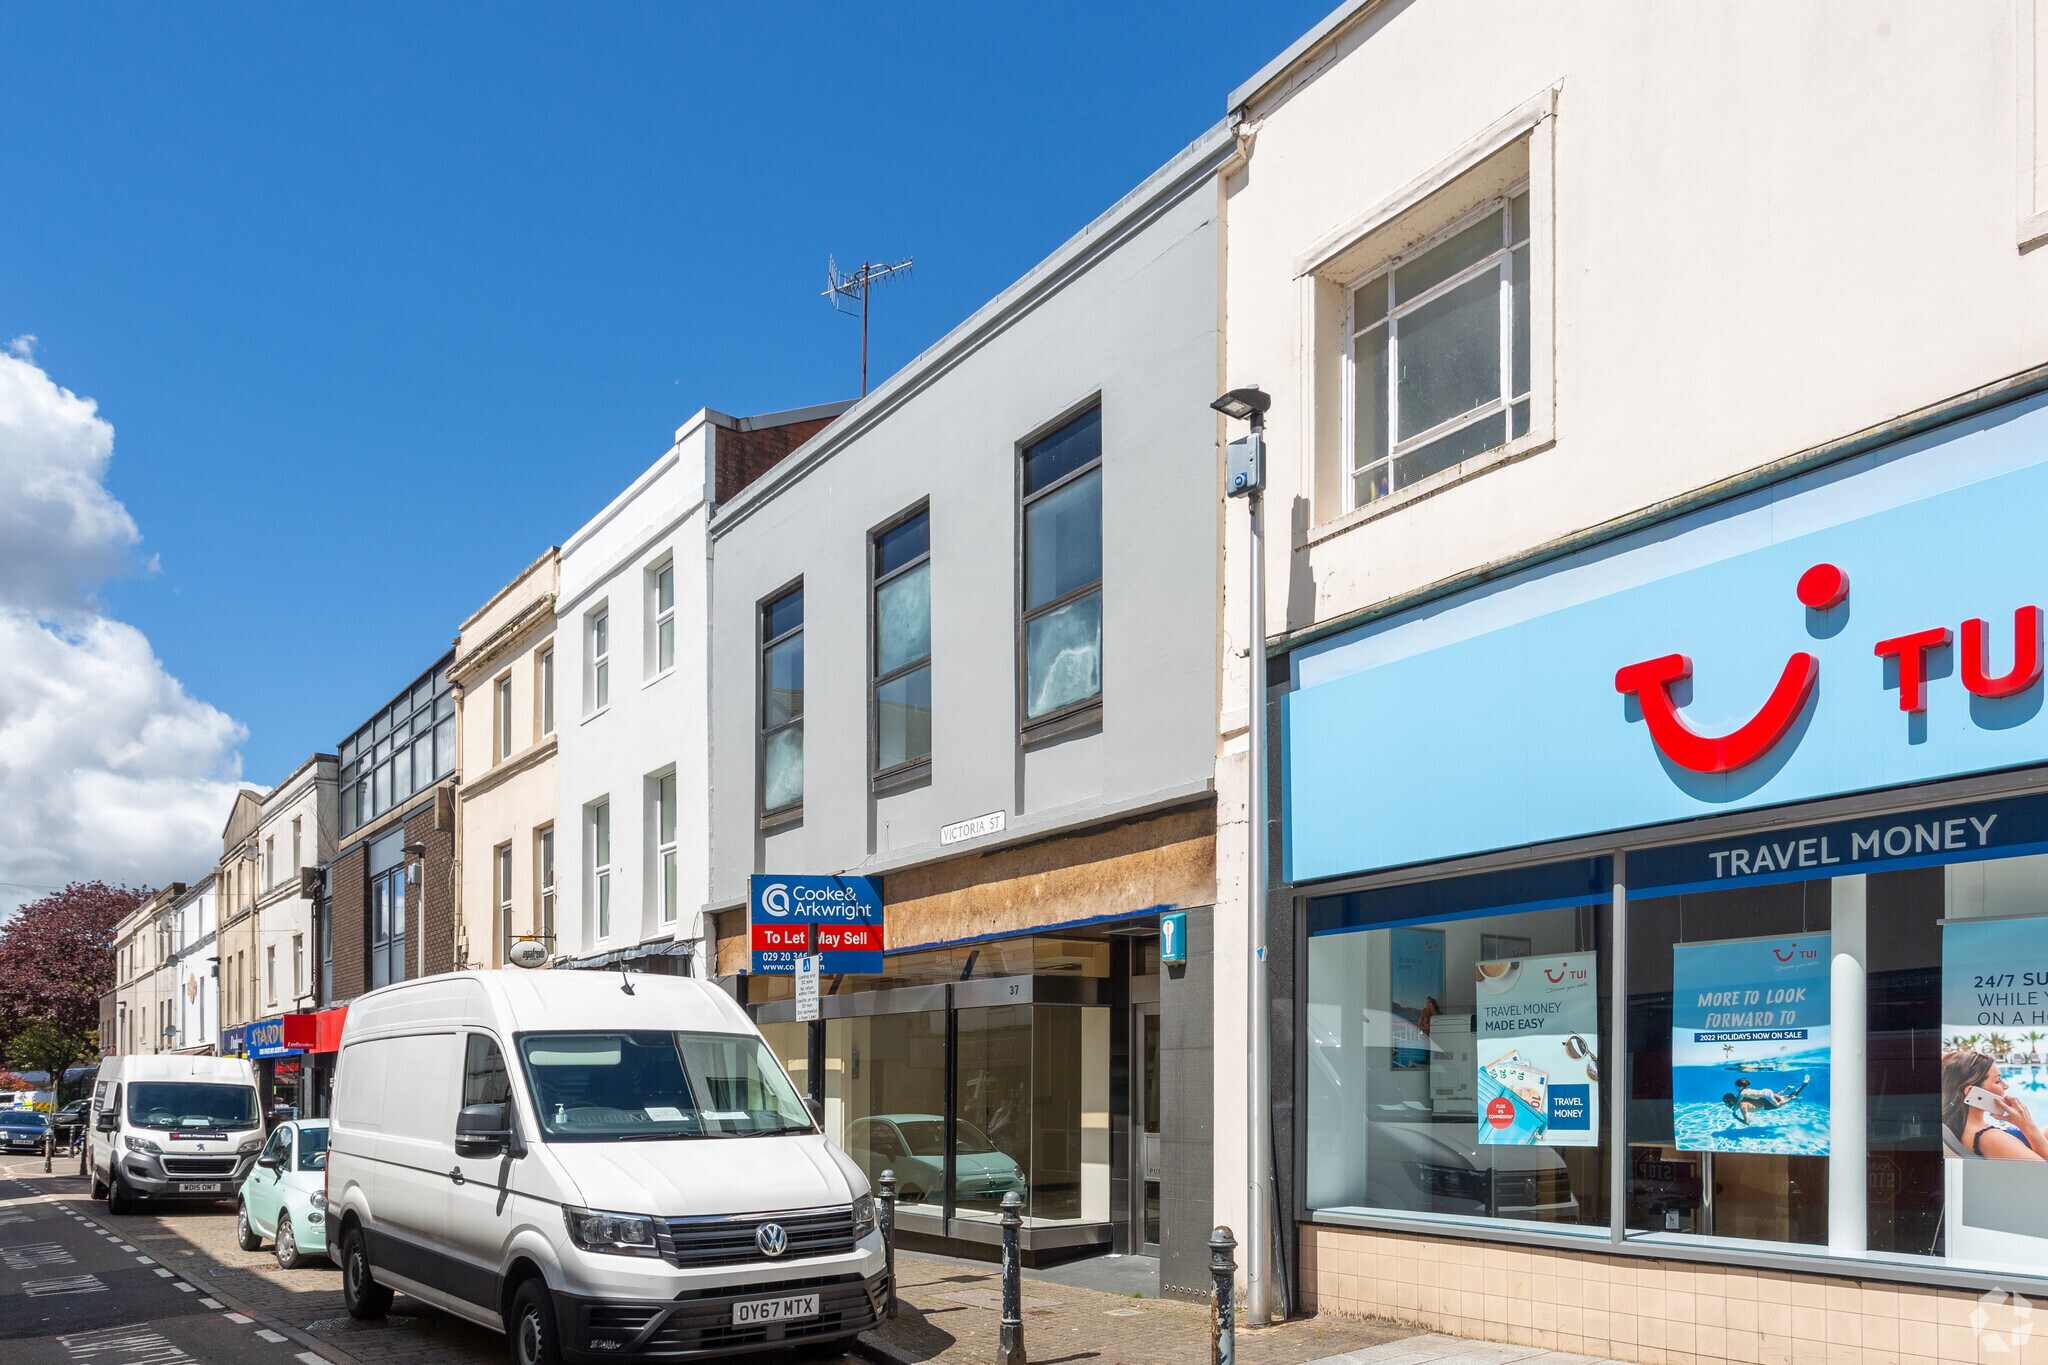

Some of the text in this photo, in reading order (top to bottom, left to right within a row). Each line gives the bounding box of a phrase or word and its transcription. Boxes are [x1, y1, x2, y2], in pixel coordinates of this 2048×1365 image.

[943, 815, 1003, 841] VICTORIA ST.
[1709, 814, 1998, 878] TRAVEL MONEY
[794, 902, 872, 920] Arkwright
[764, 930, 780, 944] To
[784, 931, 805, 944] Let
[843, 931, 868, 945] Sell
[763, 952, 778, 961] 029
[780, 952, 791, 961] 20
[1800, 950, 1817, 959] TUI
[1570, 969, 1587, 979] TUI
[1974, 973, 2015, 988] 24/7
[1009, 985, 1019, 995] 37
[1698, 987, 1807, 1008] MORE TO LOOK
[1977, 991, 2038, 1007] WHILE
[1485, 1001, 1562, 1018] TRAVEL MONEY
[1485, 1018, 1546, 1032] MADE EASY
[1705, 1010, 1797, 1029] FORWARD TO
[1977, 1010, 2048, 1025] ON A H
[251, 1024, 284, 1047] STARD
[1700, 1031, 1803, 1041] 2022 HOLIDAYS NOW ON SALE
[1553, 1097, 1583, 1106] TRAVEL
[1554, 1109, 1583, 1118] MONEY
[739, 1297, 813, 1321] OY67 MTX
